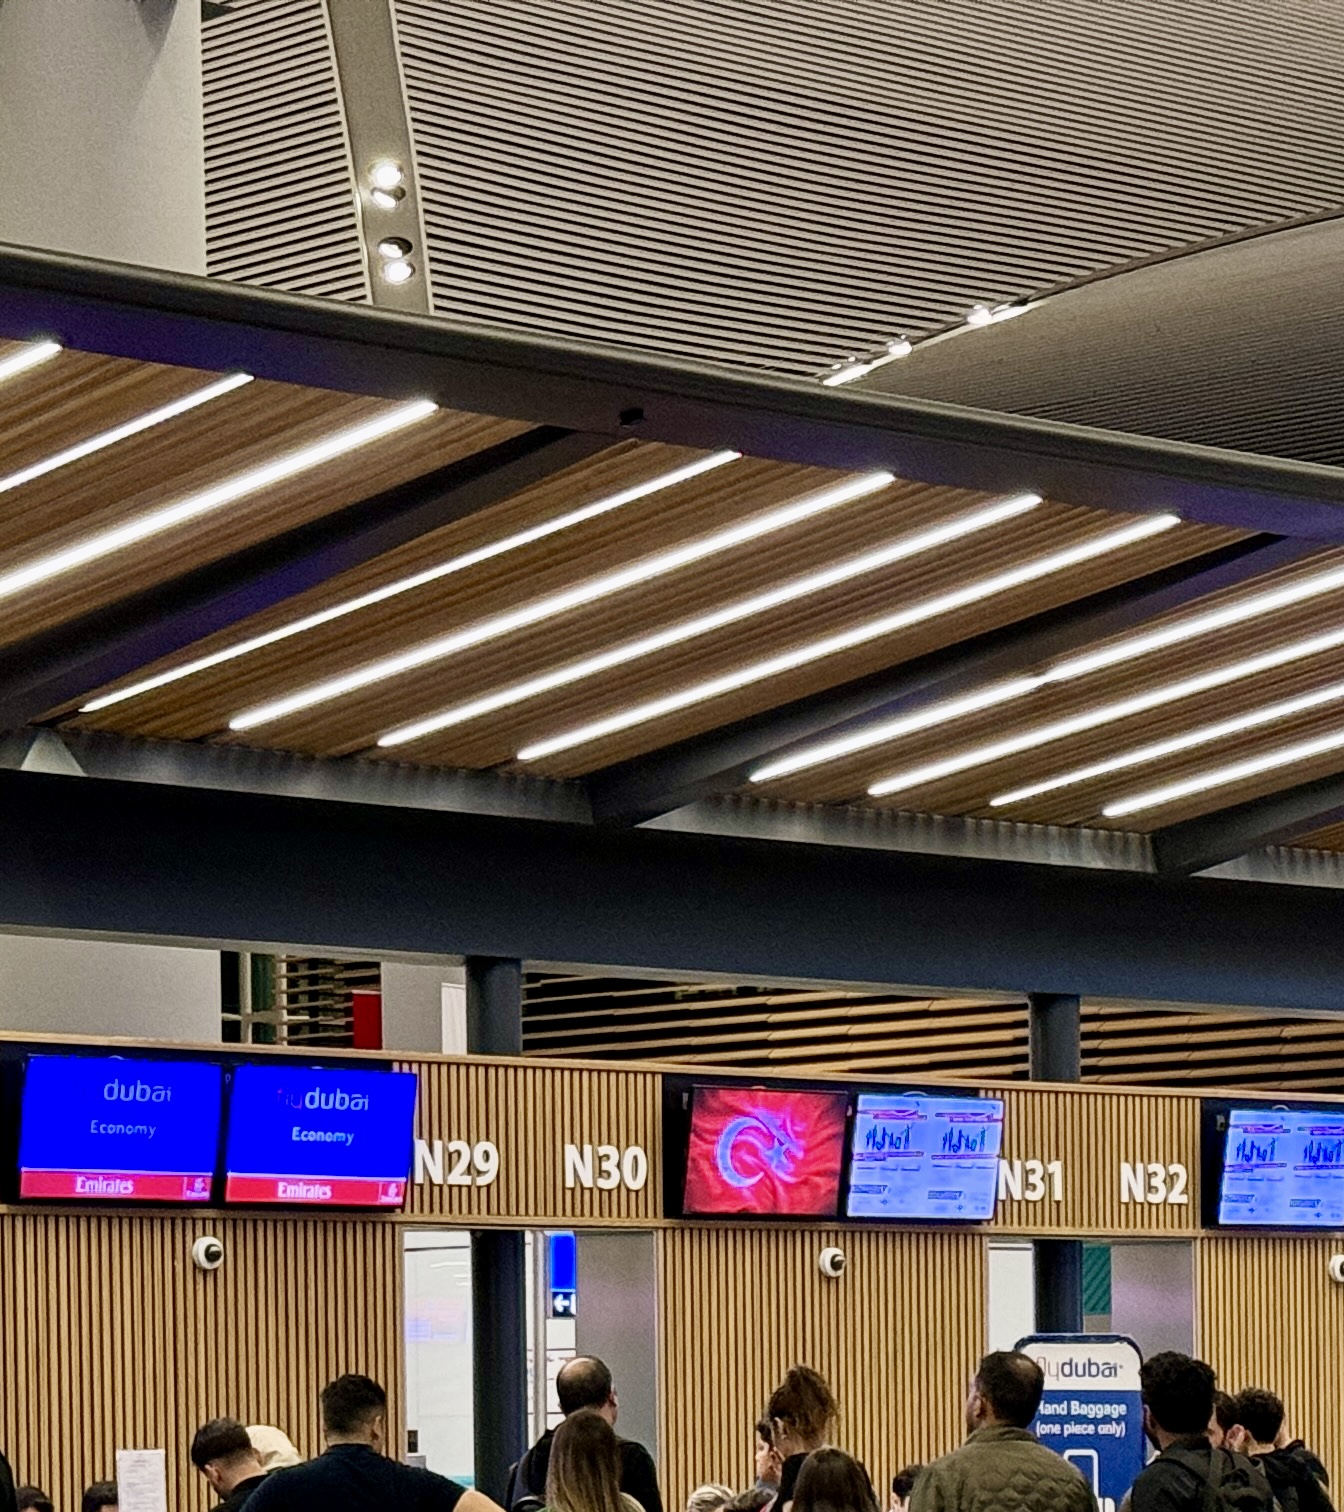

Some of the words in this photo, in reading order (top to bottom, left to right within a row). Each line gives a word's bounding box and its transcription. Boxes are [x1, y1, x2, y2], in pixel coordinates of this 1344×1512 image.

[90, 1120, 156, 1139] Economy
[292, 1127, 354, 1146] Economy
[414, 1139, 499, 1186] N29
[564, 1144, 648, 1190] N30
[75, 1176, 134, 1194] Emirates
[998, 1159, 1063, 1201] N31
[1120, 1162, 1188, 1204] N32
[277, 1182, 332, 1200] Emirates
[1071, 1400, 1128, 1419] Baggage
[1036, 1421, 1062, 1438] (one
[1063, 1421, 1096, 1438] piece
[1097, 1421, 1126, 1438] only)
